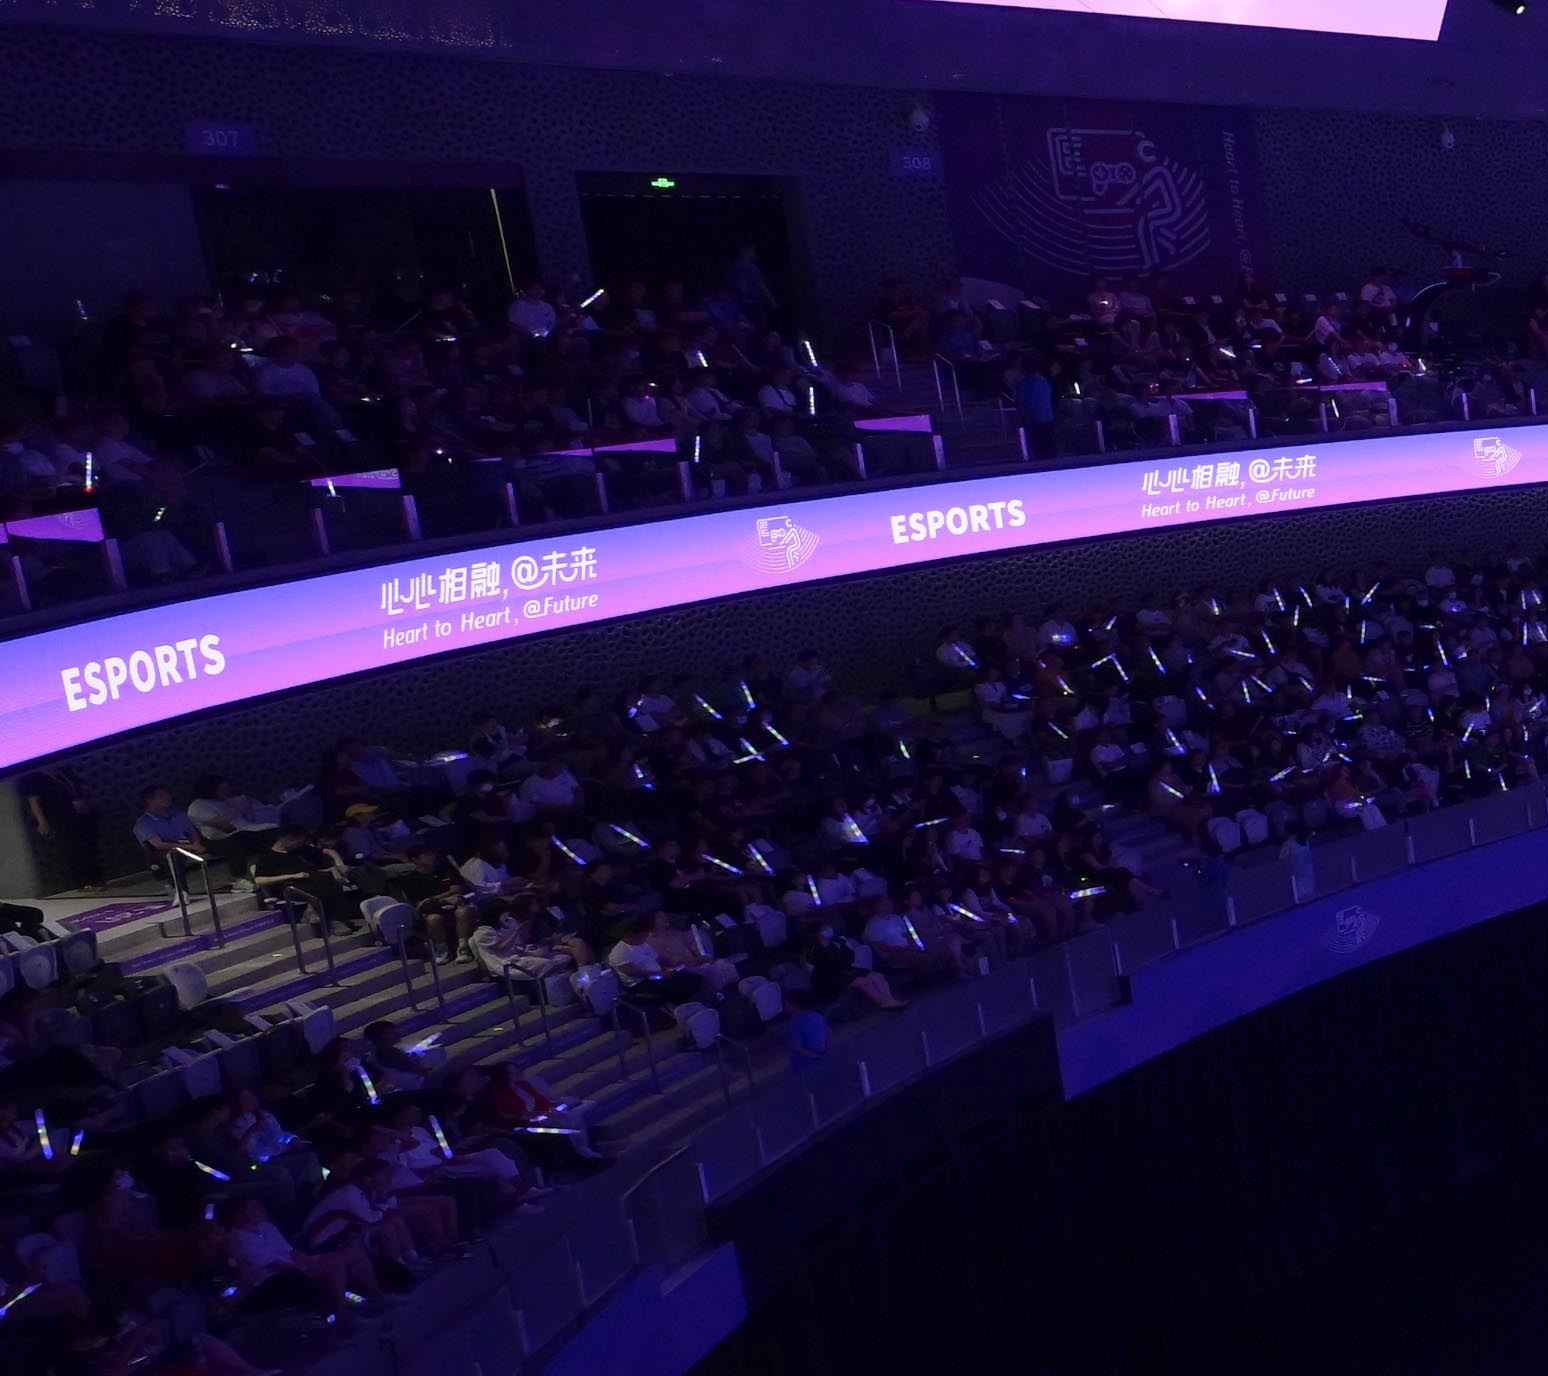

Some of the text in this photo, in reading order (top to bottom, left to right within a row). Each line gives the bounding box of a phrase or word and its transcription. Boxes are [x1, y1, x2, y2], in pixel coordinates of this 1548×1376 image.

[200, 129, 240, 147] 307
[890, 498, 1027, 545] ESPORTS
[1141, 501, 1181, 519] Heart
[1186, 499, 1200, 513] to
[1255, 487, 1316, 506] @Future
[381, 545, 598, 617] 心心相融,@未来
[383, 622, 429, 649] Heart
[435, 619, 453, 640] to
[523, 593, 600, 620] @Future
[61, 633, 226, 713] ESPORTS
